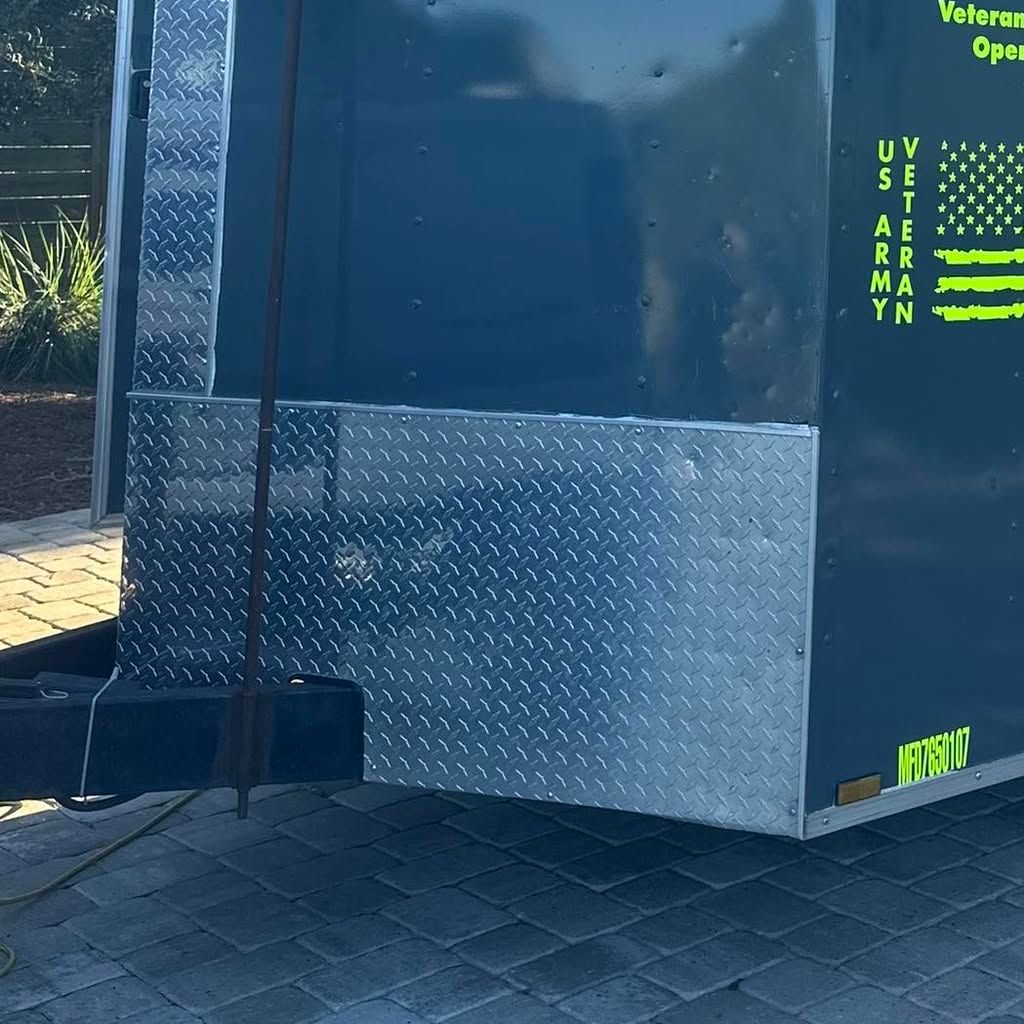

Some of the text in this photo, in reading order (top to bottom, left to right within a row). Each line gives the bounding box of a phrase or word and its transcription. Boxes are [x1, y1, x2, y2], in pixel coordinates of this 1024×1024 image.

[870, 140, 895, 321] US ARMY
[895, 137, 919, 324] VETERAN
